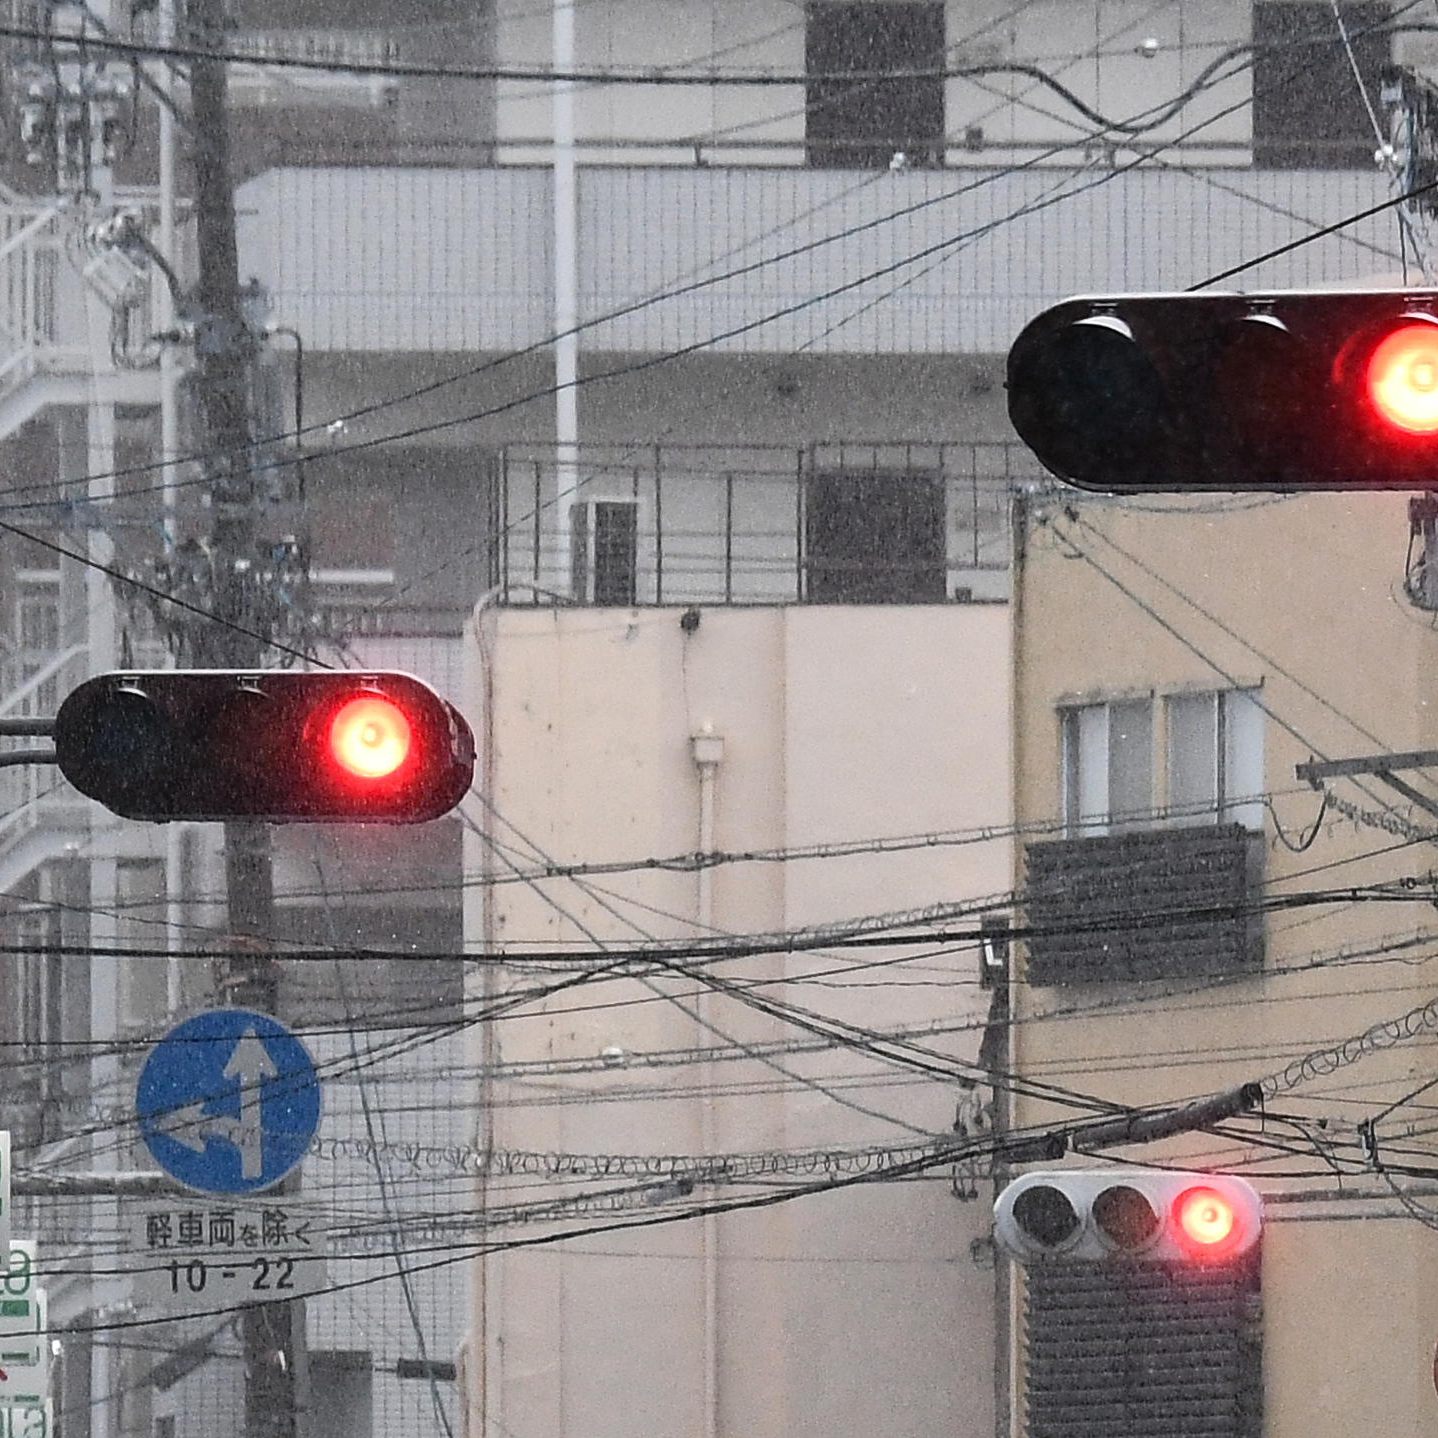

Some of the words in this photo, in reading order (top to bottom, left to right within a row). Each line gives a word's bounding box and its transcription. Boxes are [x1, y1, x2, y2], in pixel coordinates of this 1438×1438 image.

[147, 1210, 310, 1247] 軽車両を除く
